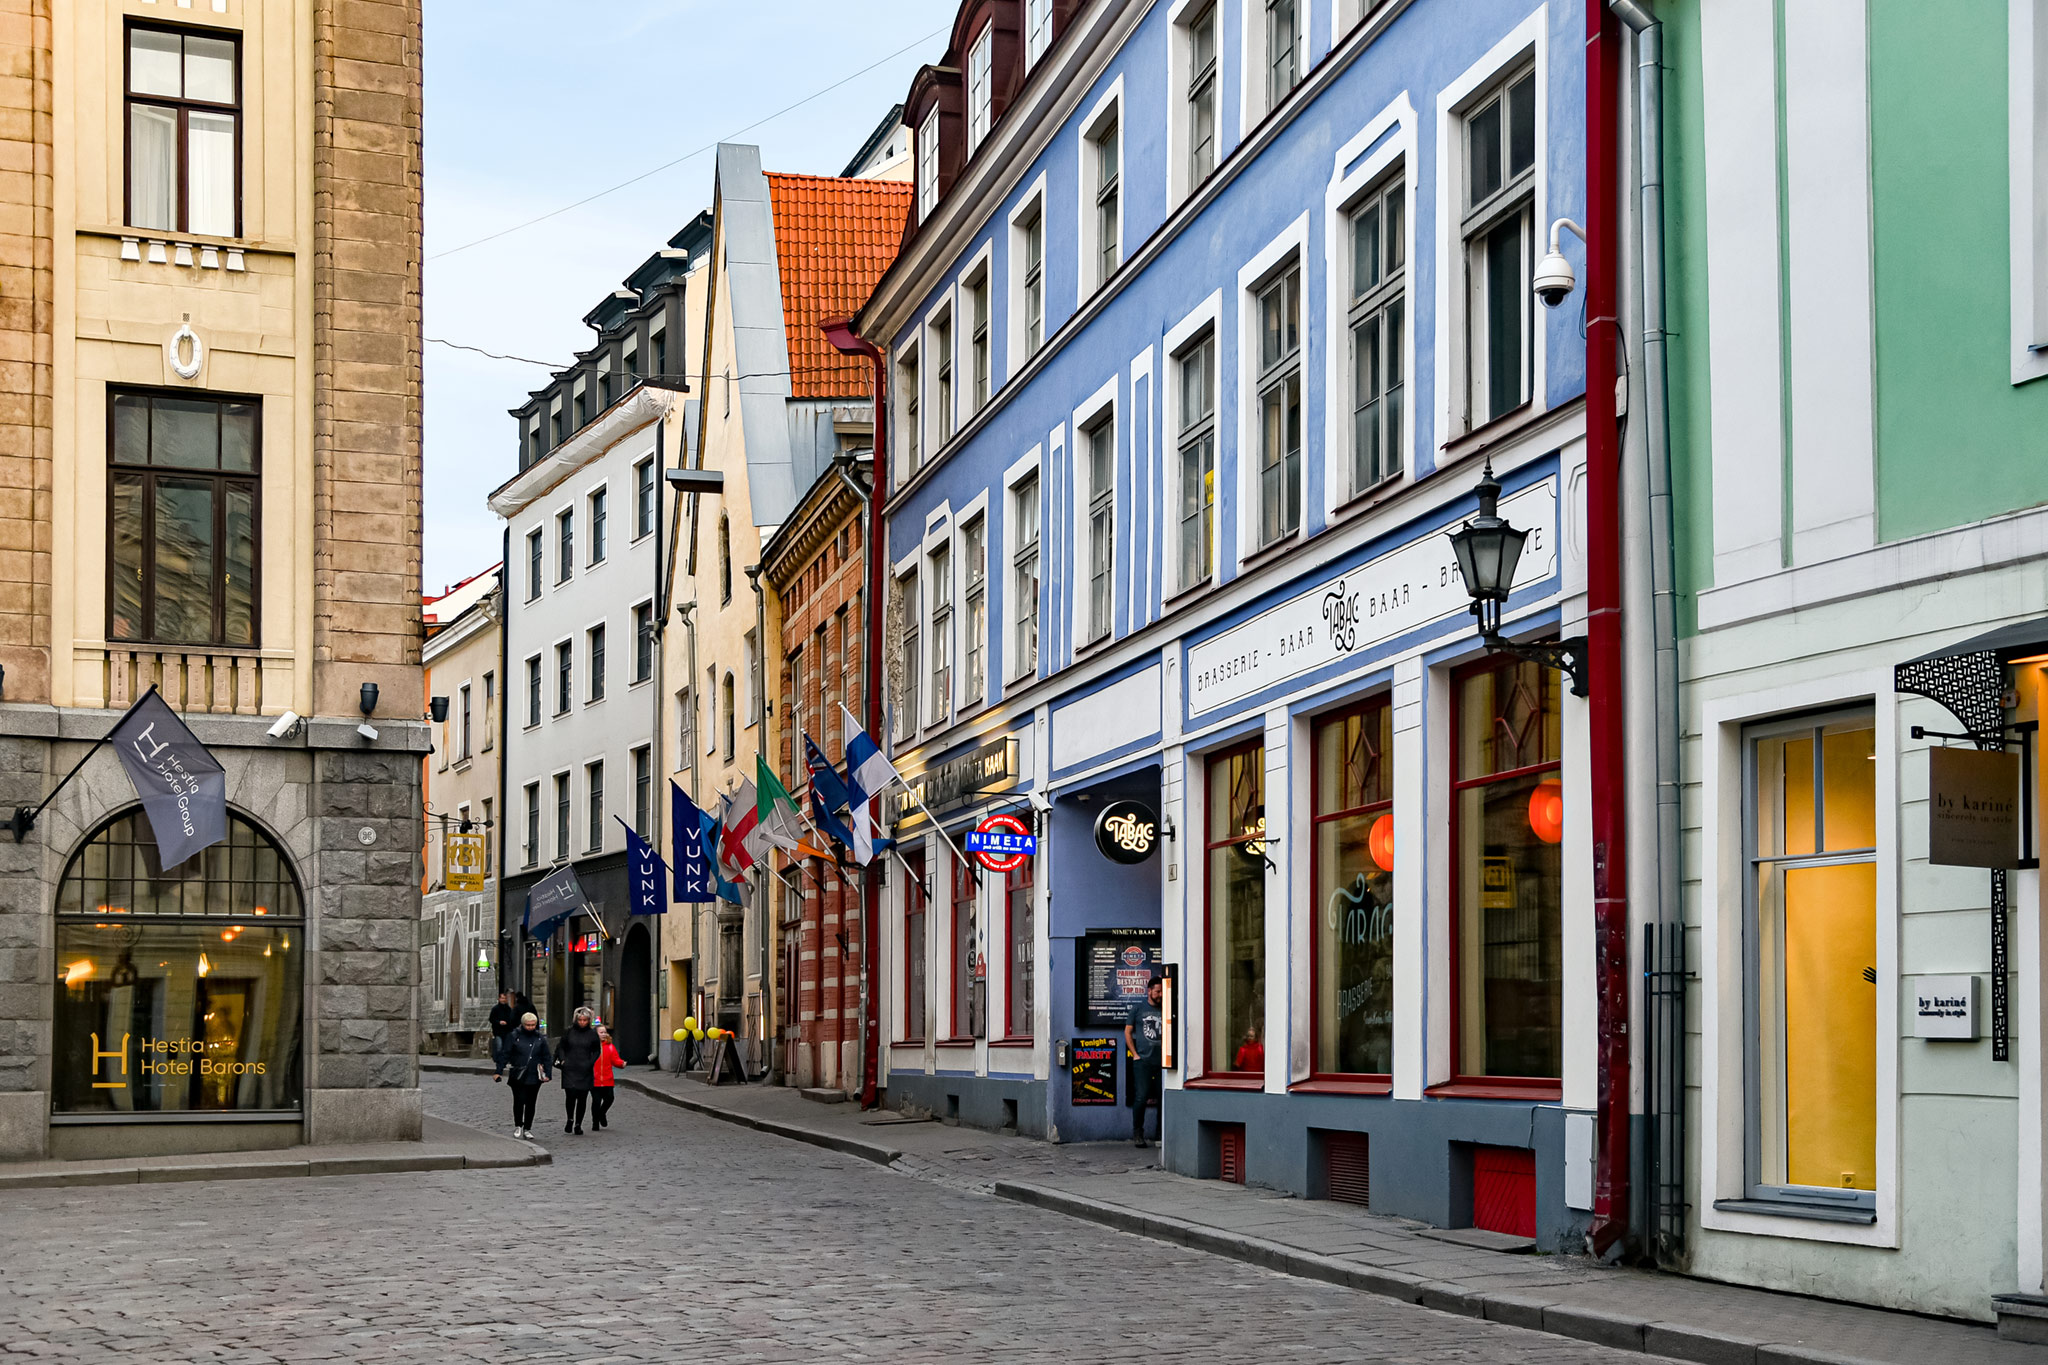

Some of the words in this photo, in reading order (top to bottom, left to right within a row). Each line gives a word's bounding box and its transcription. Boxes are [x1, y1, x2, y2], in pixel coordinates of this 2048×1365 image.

[1323, 580, 1360, 652] TABAC
[1370, 584, 1410, 618] BAAR
[1197, 650, 1258, 692] BRASSERIE
[1280, 626, 1314, 657] BAAR
[167, 754, 199, 794] Hestia
[178, 797, 195, 837] Group
[1938, 792, 1953, 813] by
[1963, 794, 2013, 812] kariné
[971, 833, 1033, 848] NIMETA
[1105, 812, 1154, 853] TABAC
[639, 847, 656, 906] VUNK
[685, 827, 702, 893] VUNK
[1919, 997, 1931, 1010] by
[1934, 996, 1966, 1007] kariné
[141, 1037, 204, 1053] Hestia
[1075, 1050, 1113, 1059] PARTY
[1080, 1038, 1107, 1047] Tonight
[141, 1059, 194, 1075] Hotel
[200, 1058, 266, 1075] Barons
